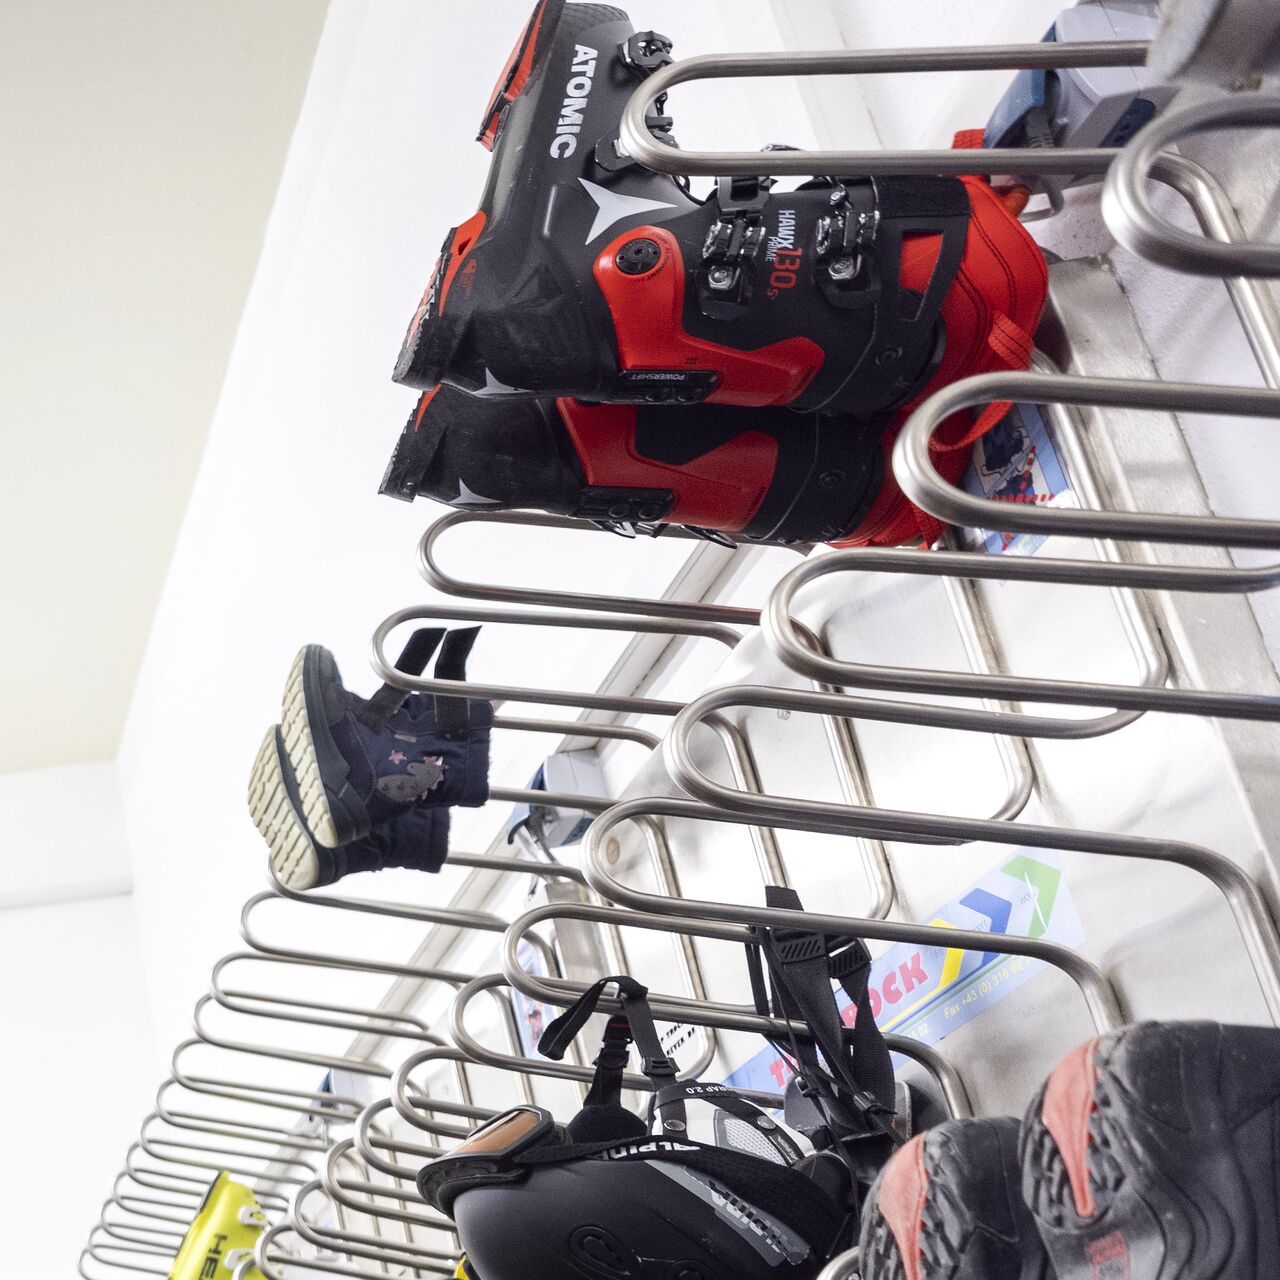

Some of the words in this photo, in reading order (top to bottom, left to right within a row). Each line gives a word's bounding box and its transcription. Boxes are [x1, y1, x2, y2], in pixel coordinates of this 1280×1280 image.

[549, 44, 599, 159] ATOMIC
[777, 209, 796, 249] HAWX
[765, 236, 777, 262] PRIME
[770, 247, 803, 289] 130
[631, 373, 686, 381] POWERSHIFT
[943, 1001, 961, 1019] Fax
[977, 982, 992, 1001] (0)
[685, 1086, 704, 1095] 2.0
